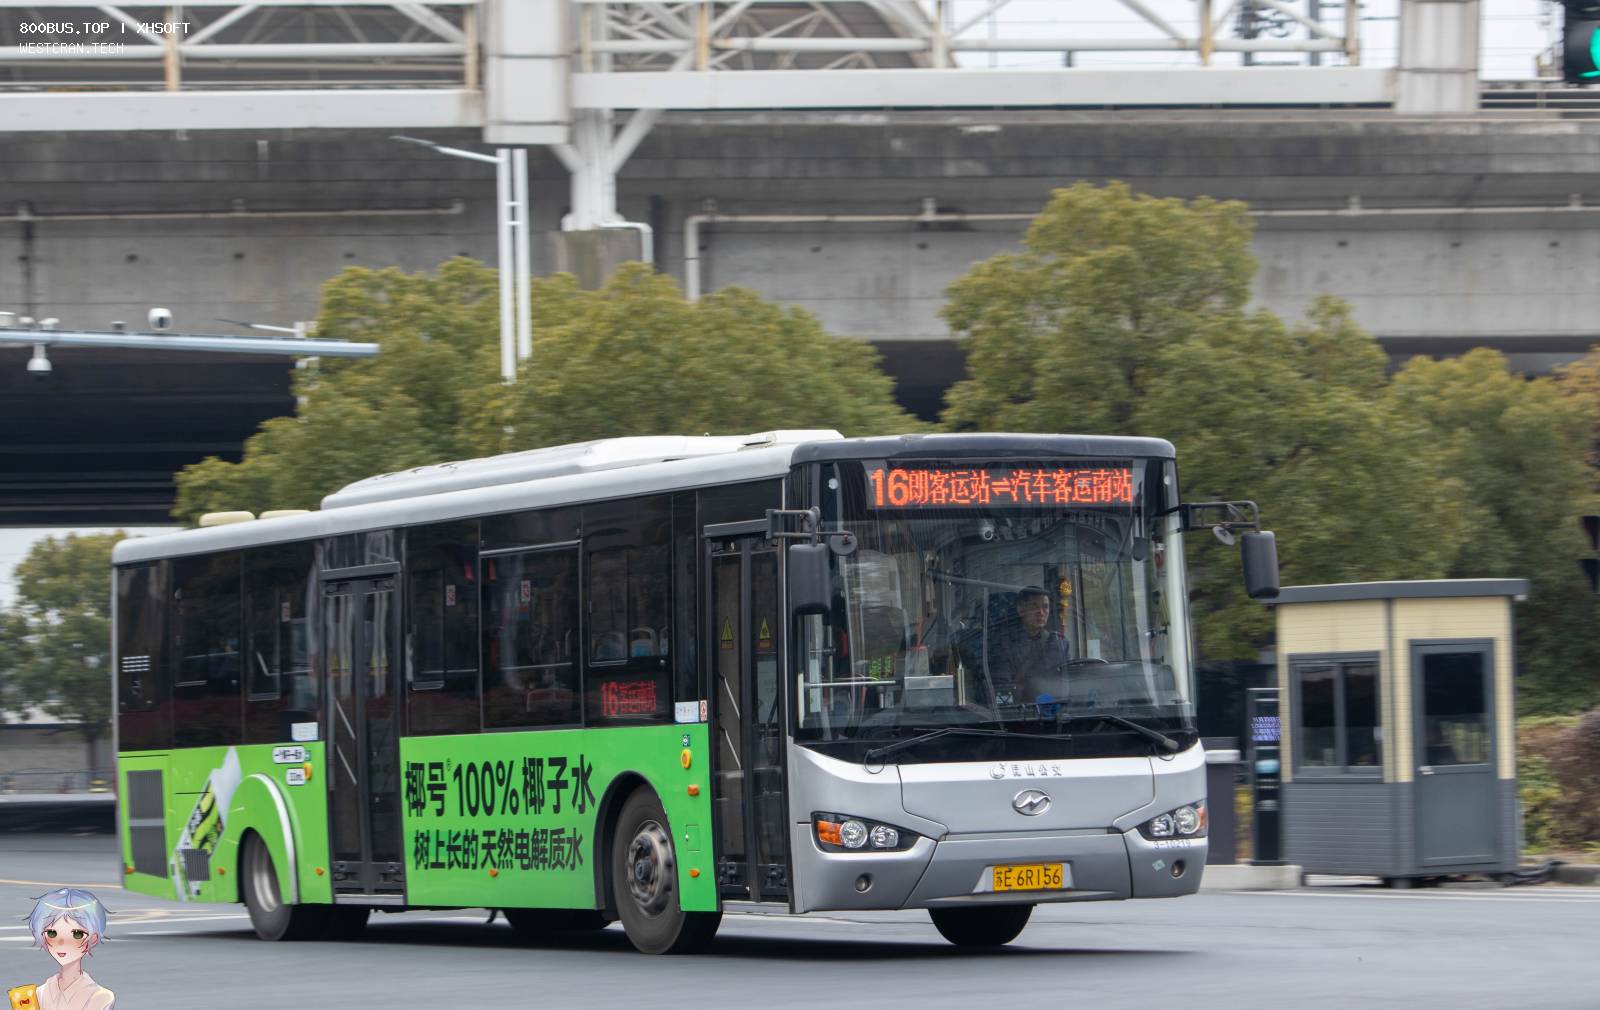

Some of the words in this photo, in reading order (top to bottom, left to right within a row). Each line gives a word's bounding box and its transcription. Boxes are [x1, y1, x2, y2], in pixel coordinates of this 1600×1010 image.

[871, 468, 909, 506] 16
[453, 759, 520, 817] 100%
[522, 754, 596, 815] 椰子水
